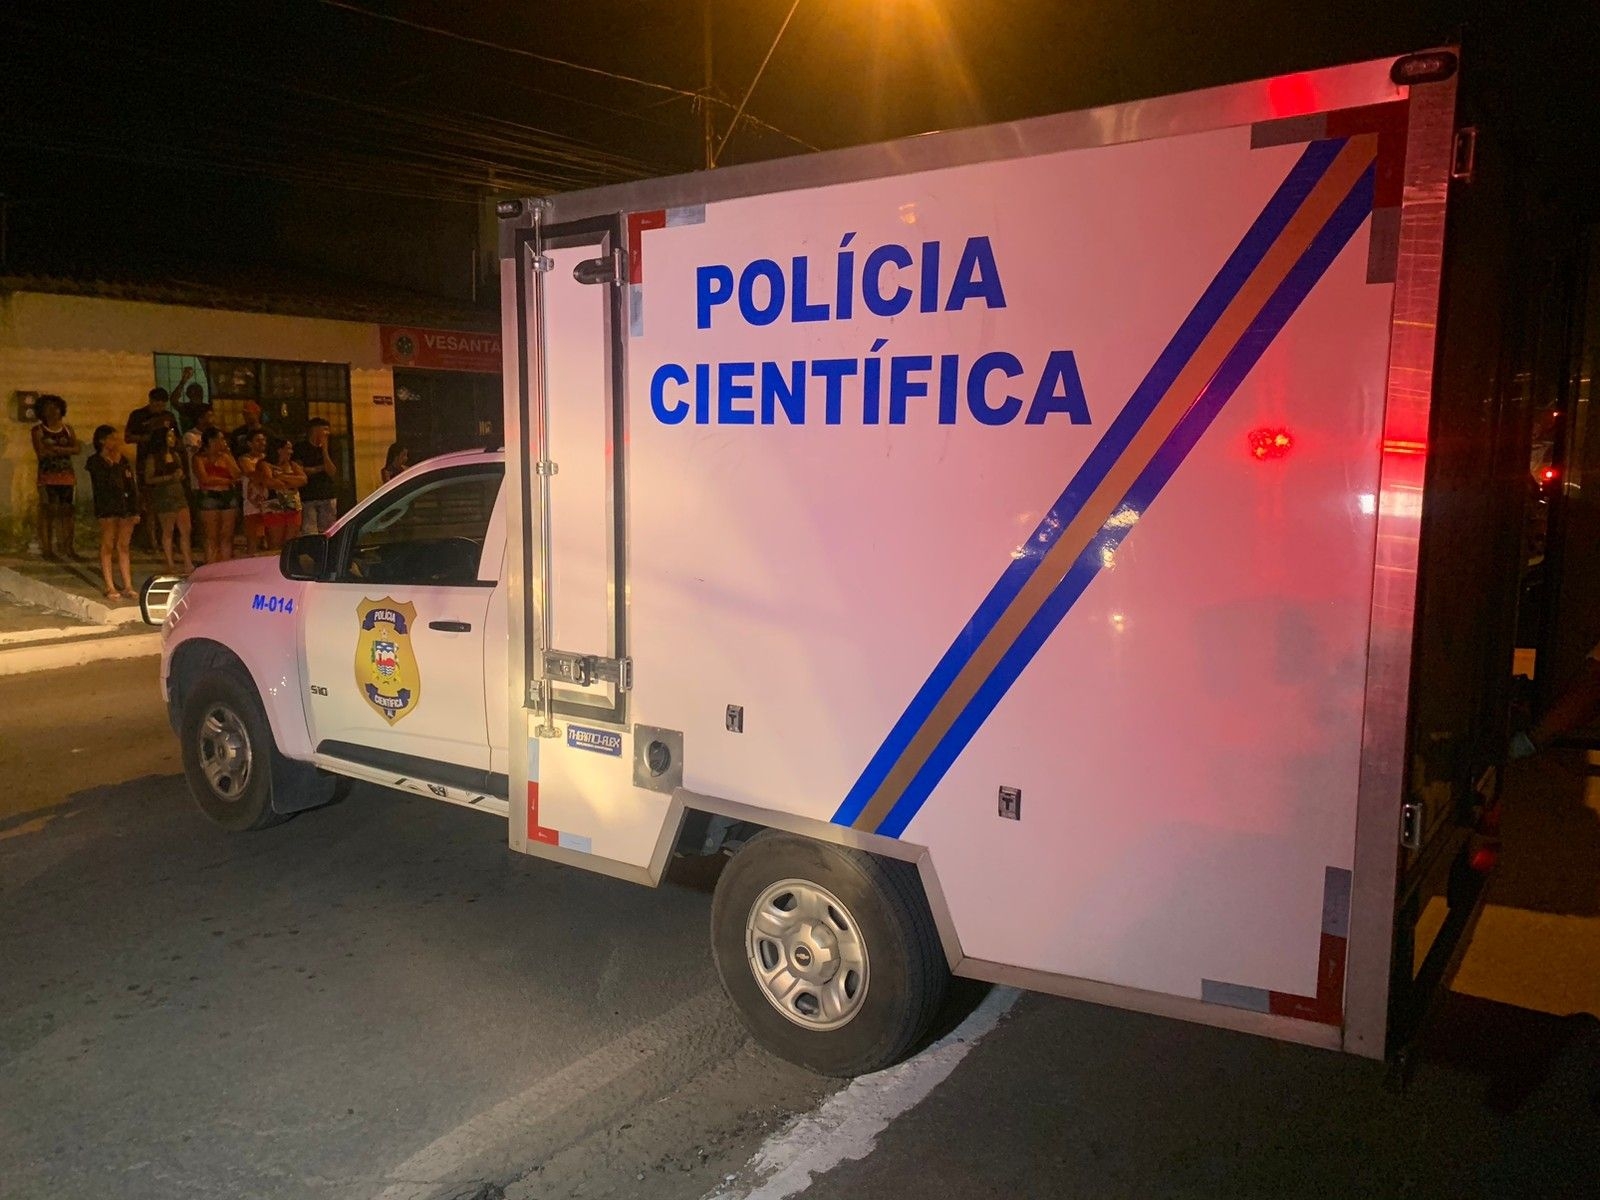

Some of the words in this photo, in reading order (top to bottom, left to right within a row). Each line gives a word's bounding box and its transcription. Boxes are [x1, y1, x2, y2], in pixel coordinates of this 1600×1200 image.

[697, 232, 1006, 329] POLÍCIA
[650, 338, 1092, 426] CIENTÍFICA
[252, 594, 293, 614] M-014
[374, 609, 396, 622] POLÍCIA
[310, 685, 328, 696] S10
[374, 694, 403, 708] CIENTÍFICA
